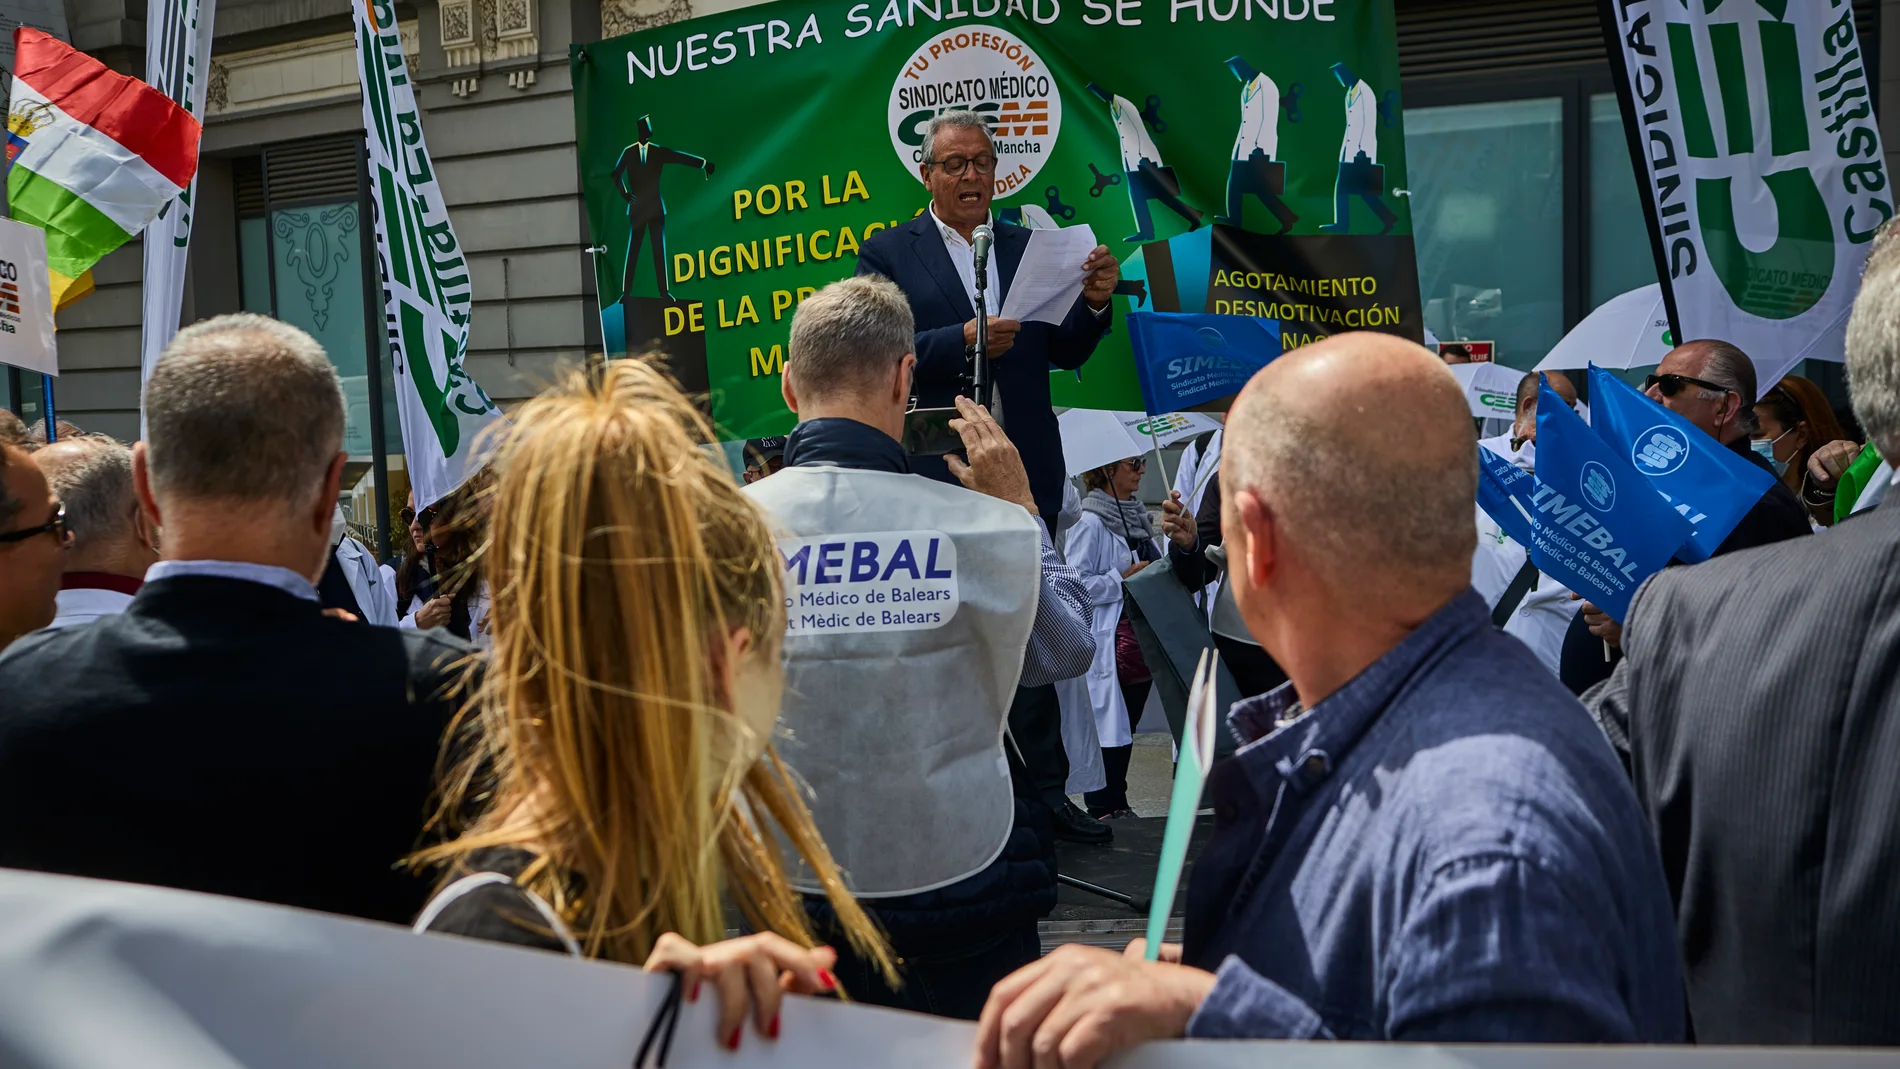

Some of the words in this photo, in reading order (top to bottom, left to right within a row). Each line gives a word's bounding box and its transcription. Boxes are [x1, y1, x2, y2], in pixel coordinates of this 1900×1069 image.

[626, 13, 823, 85] NUESTRA
[844, 0, 1060, 38] SANIDAD
[1082, 0, 1142, 25] SE
[1170, 0, 1335, 23] HUNDE
[904, 55, 929, 81] TU
[929, 32, 1035, 72] PROFESIÓN
[899, 78, 986, 110] SINDICATO
[989, 71, 1050, 100] MÉDICO
[734, 179, 808, 220] POR
[822, 170, 870, 205] LA
[1214, 269, 1377, 297] AGOTAMIENTO
[664, 302, 706, 336] DE
[718, 294, 760, 328] LA
[1215, 300, 1400, 328] DESMOTIVACIÓN
[1171, 375, 1206, 391] Sindicato
[1177, 383, 1208, 398] Sindicat
[1535, 536, 1564, 562] Mèdic
[1564, 556, 1577, 571] de
[1577, 566, 1614, 596] Balears
[1543, 526, 1577, 554] Médico
[1577, 551, 1591, 564] de
[1591, 560, 1626, 591] Balears
[800, 591, 860, 608] Médico
[865, 589, 886, 603] de
[891, 587, 951, 602] Balears
[801, 613, 850, 629] Mèdic
[855, 612, 876, 627] de
[882, 610, 941, 624] Balears
